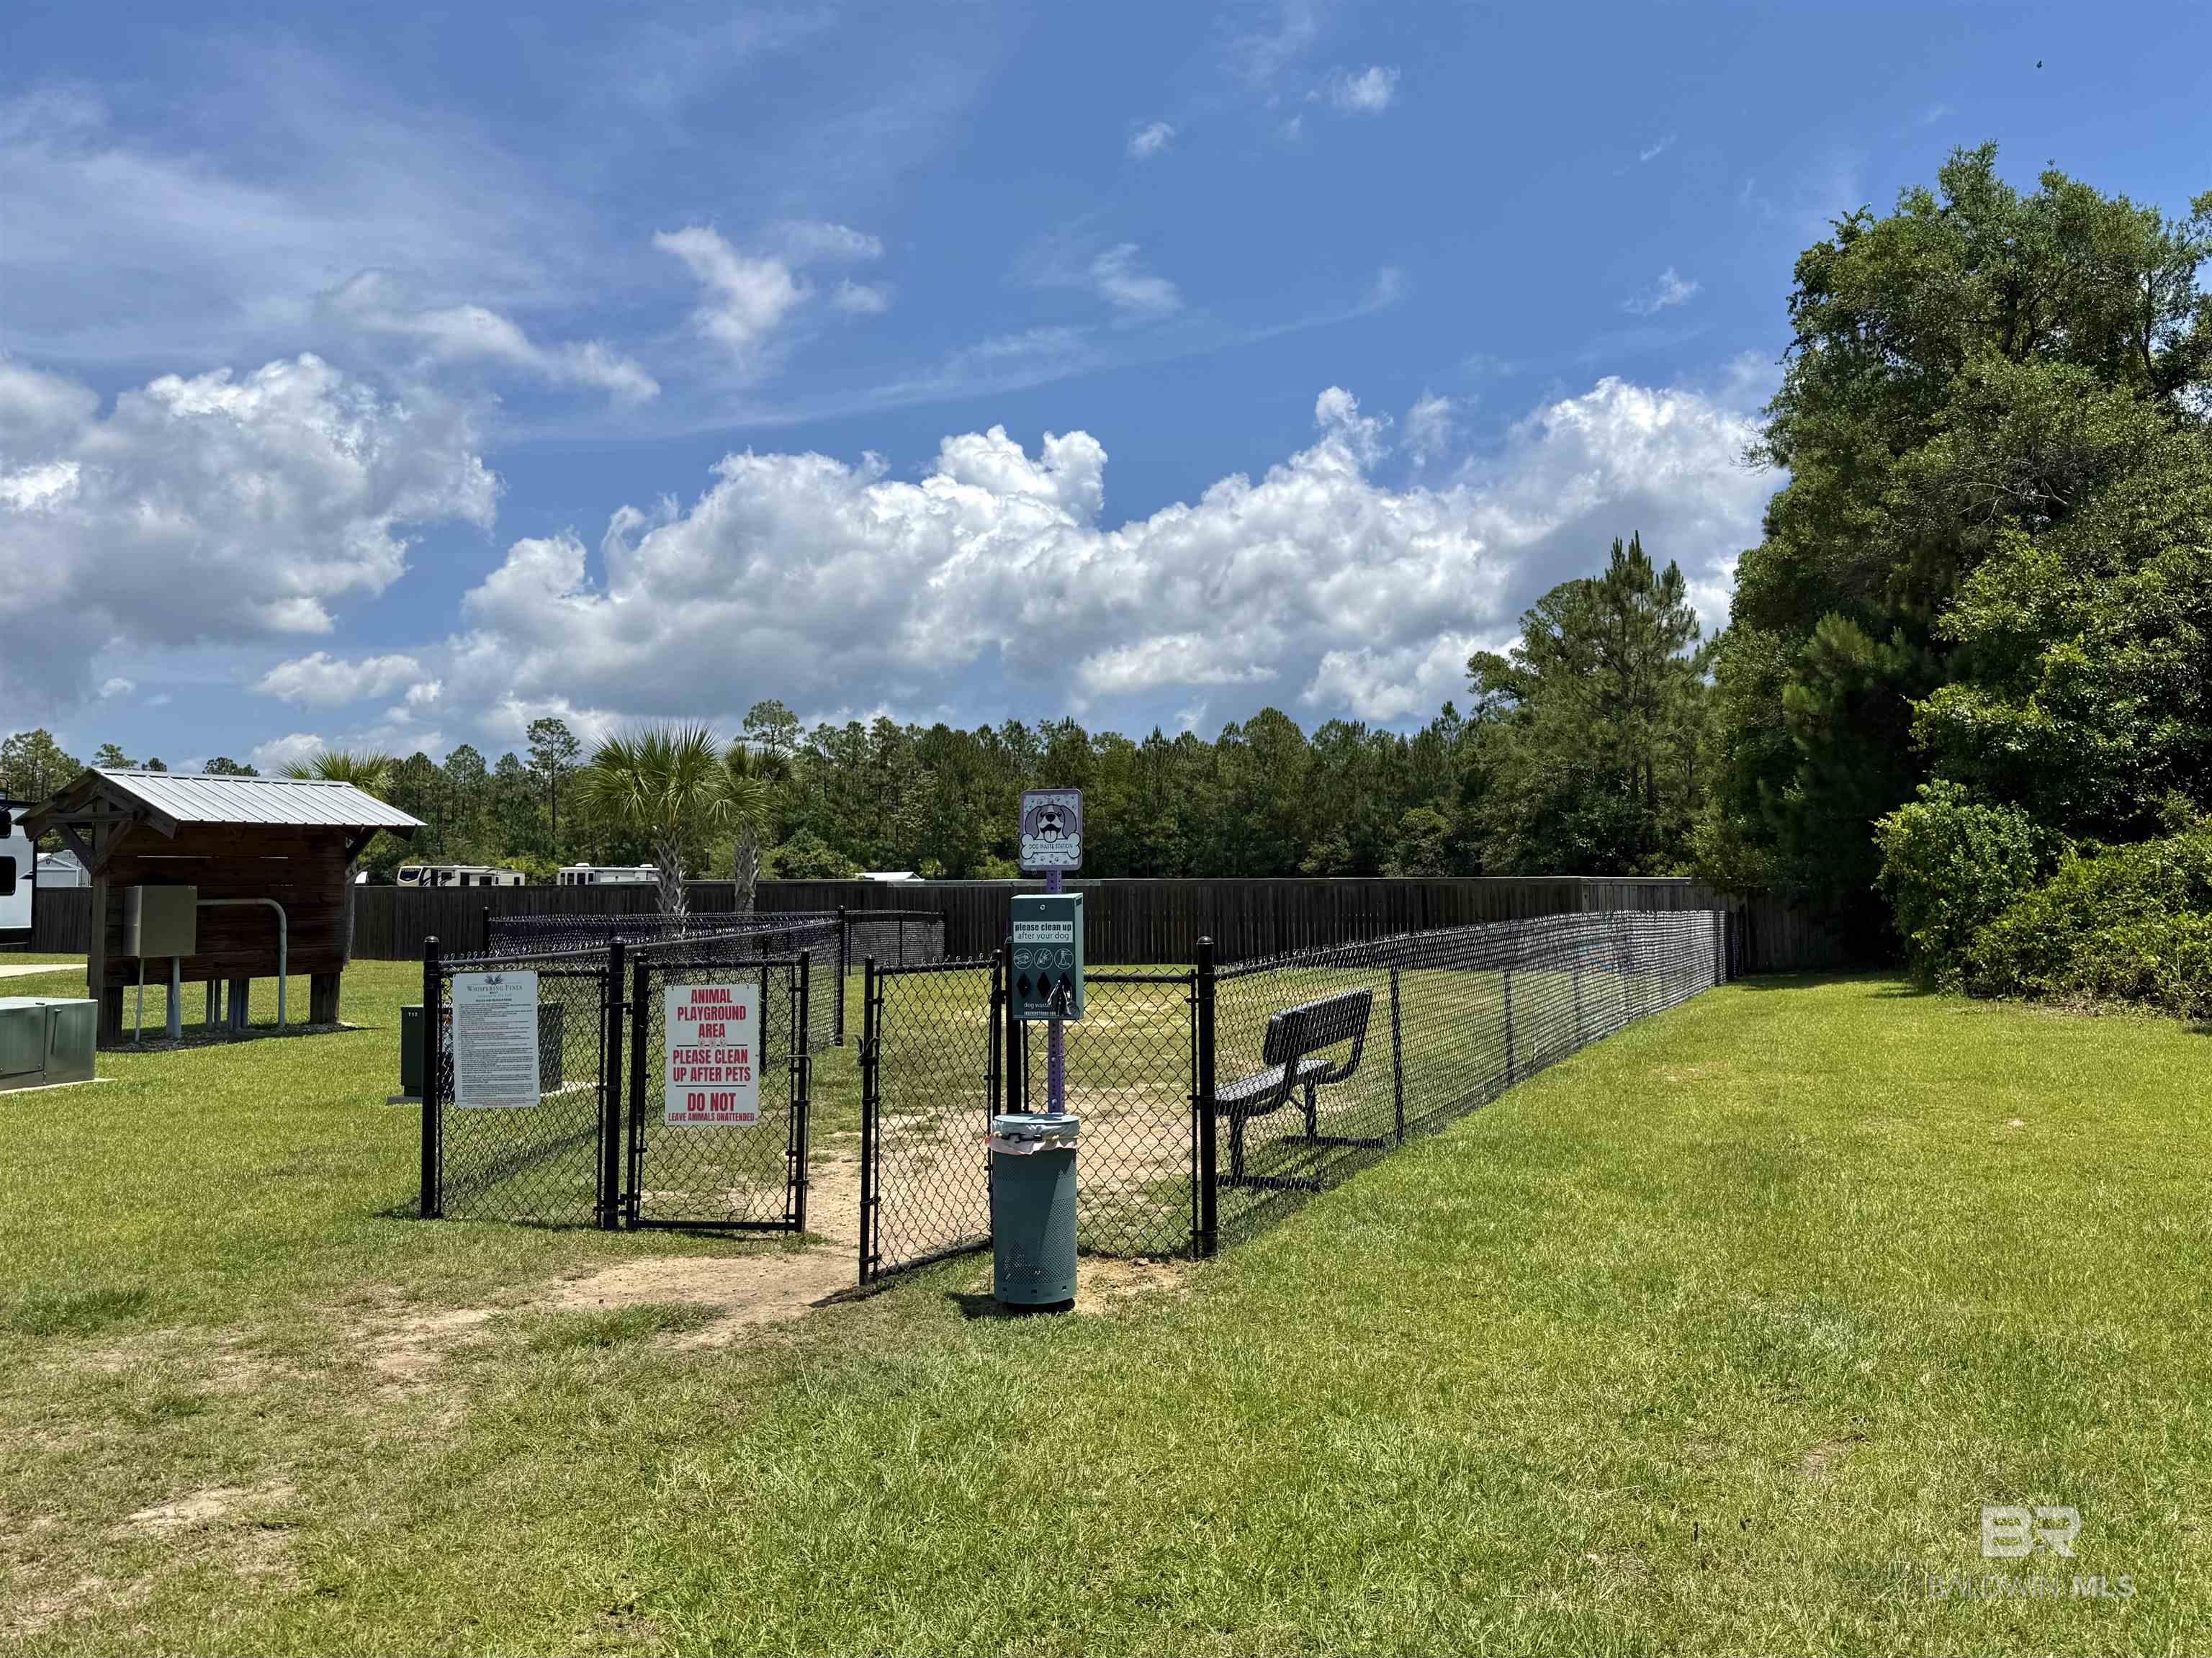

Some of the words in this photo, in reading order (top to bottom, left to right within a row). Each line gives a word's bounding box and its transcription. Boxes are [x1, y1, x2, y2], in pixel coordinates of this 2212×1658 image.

[1015, 923, 1039, 932] please
[1054, 932, 1069, 941] dog
[691, 988, 732, 1004] ANIMAL
[677, 1006, 746, 1021] PLAYGROUND
[698, 1023, 726, 1038] AREA
[673, 1050, 711, 1064] PLEASE
[714, 1049, 748, 1064] CLEAN
[673, 1067, 687, 1082] UP
[690, 1067, 722, 1082] AFTER
[725, 1066, 751, 1081] PETS
[687, 1093, 706, 1112] DO
[710, 1093, 736, 1112] NOT
[668, 1113, 686, 1122] LEAVE
[688, 1112, 715, 1122] ANIMALS
[716, 1112, 755, 1122] UNATTENDED
